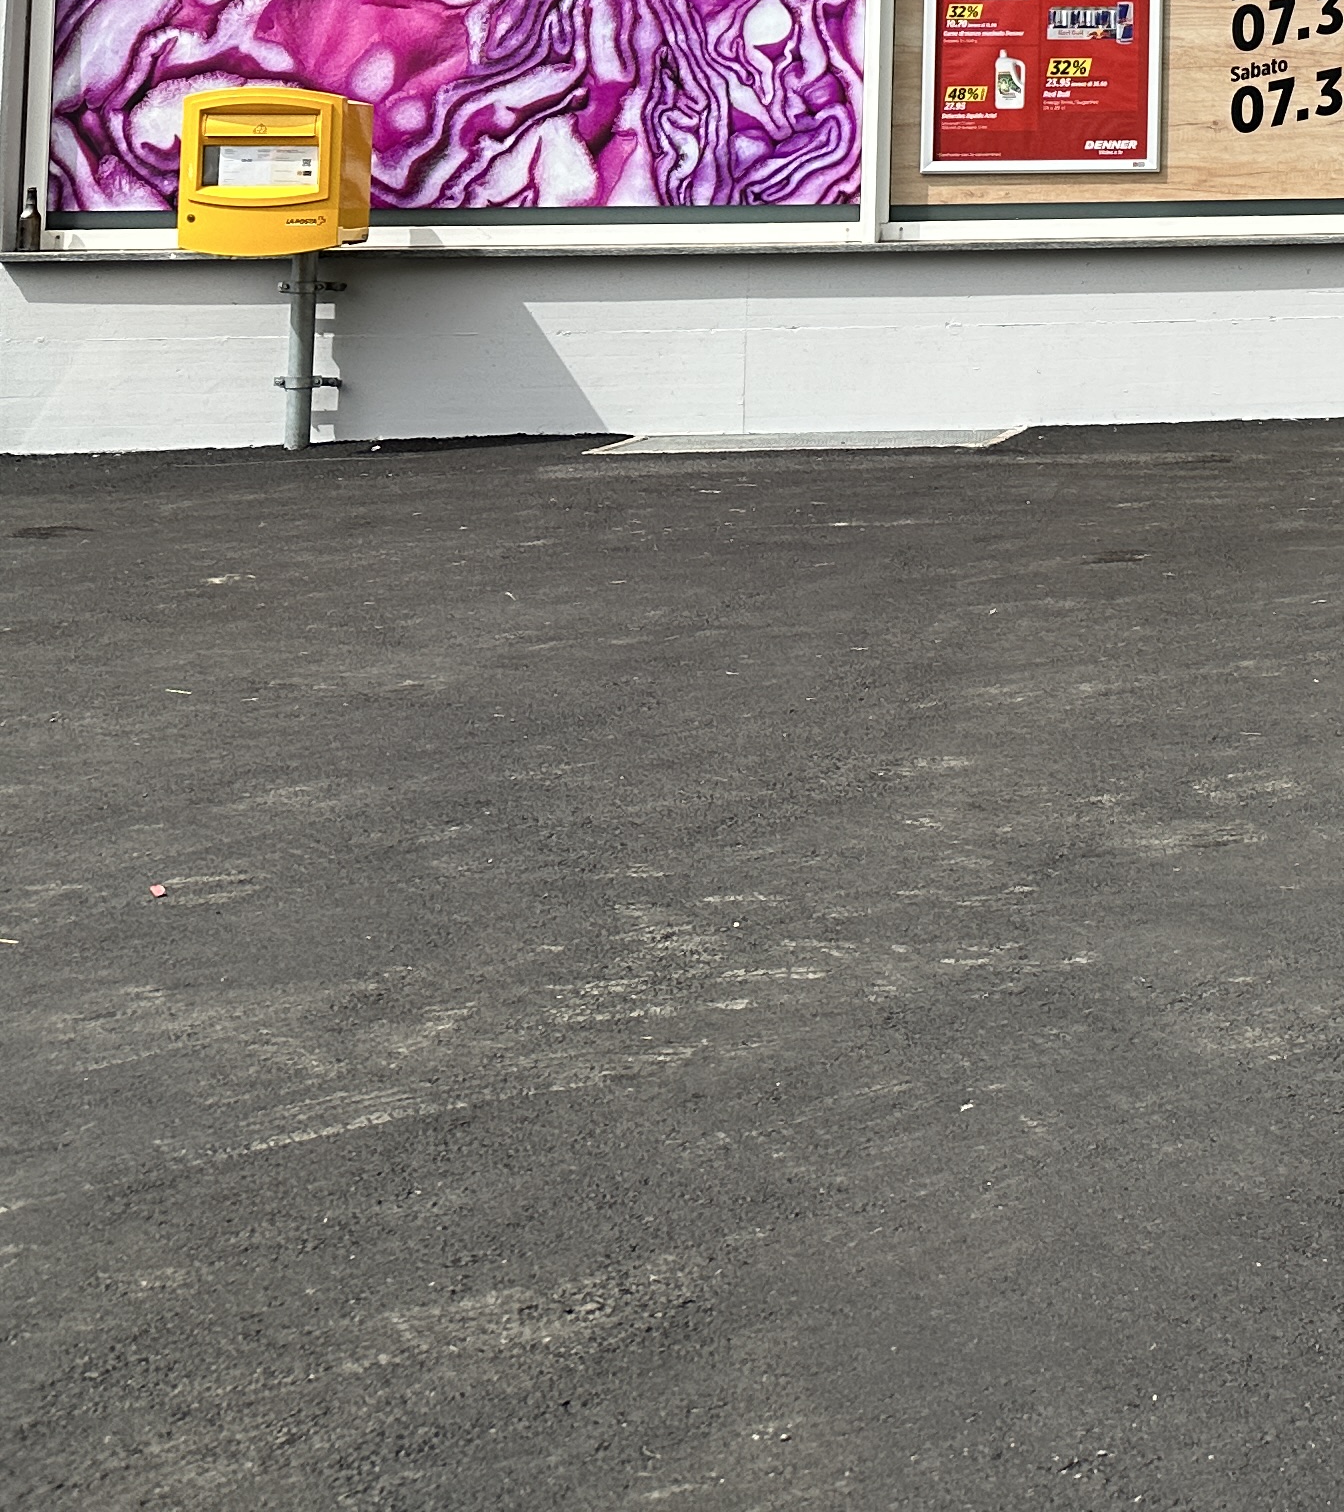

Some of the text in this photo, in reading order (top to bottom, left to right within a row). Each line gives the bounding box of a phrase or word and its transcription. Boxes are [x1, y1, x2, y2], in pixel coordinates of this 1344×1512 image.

[949, 5, 979, 18] 32%
[1050, 60, 1087, 76] 32%
[1230, 60, 1288, 82] Sabato
[947, 88, 979, 100] 48%
[1084, 140, 1138, 150] DENNER
